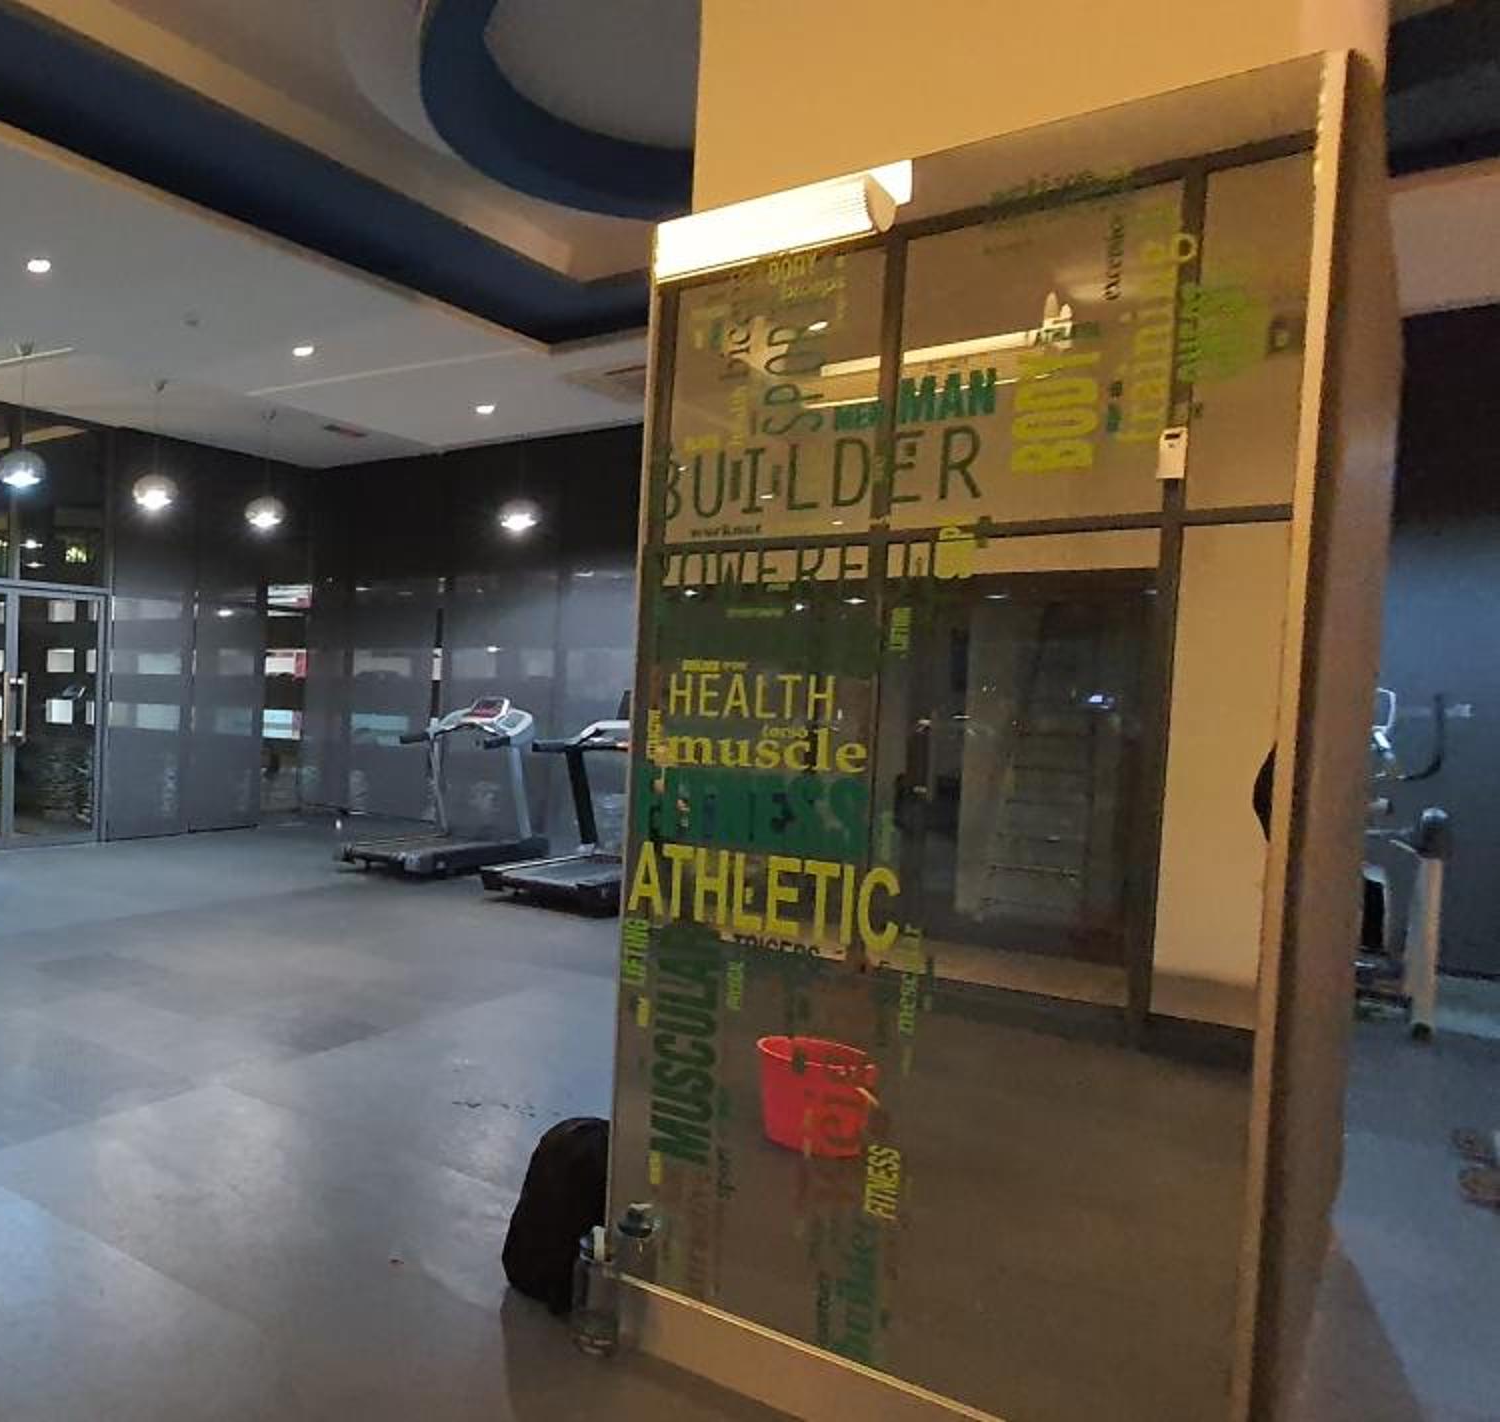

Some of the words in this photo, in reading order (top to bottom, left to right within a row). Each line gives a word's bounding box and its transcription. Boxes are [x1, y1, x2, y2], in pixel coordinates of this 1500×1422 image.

[900, 367, 997, 425] MAN
[1011, 350, 1100, 475] BODY
[660, 425, 983, 521] BUILDER
[667, 672, 837, 721] HEALTH
[666, 727, 868, 774] muscle
[627, 841, 901, 949] ATHLETIC
[862, 1143, 902, 1221] FITNESS
